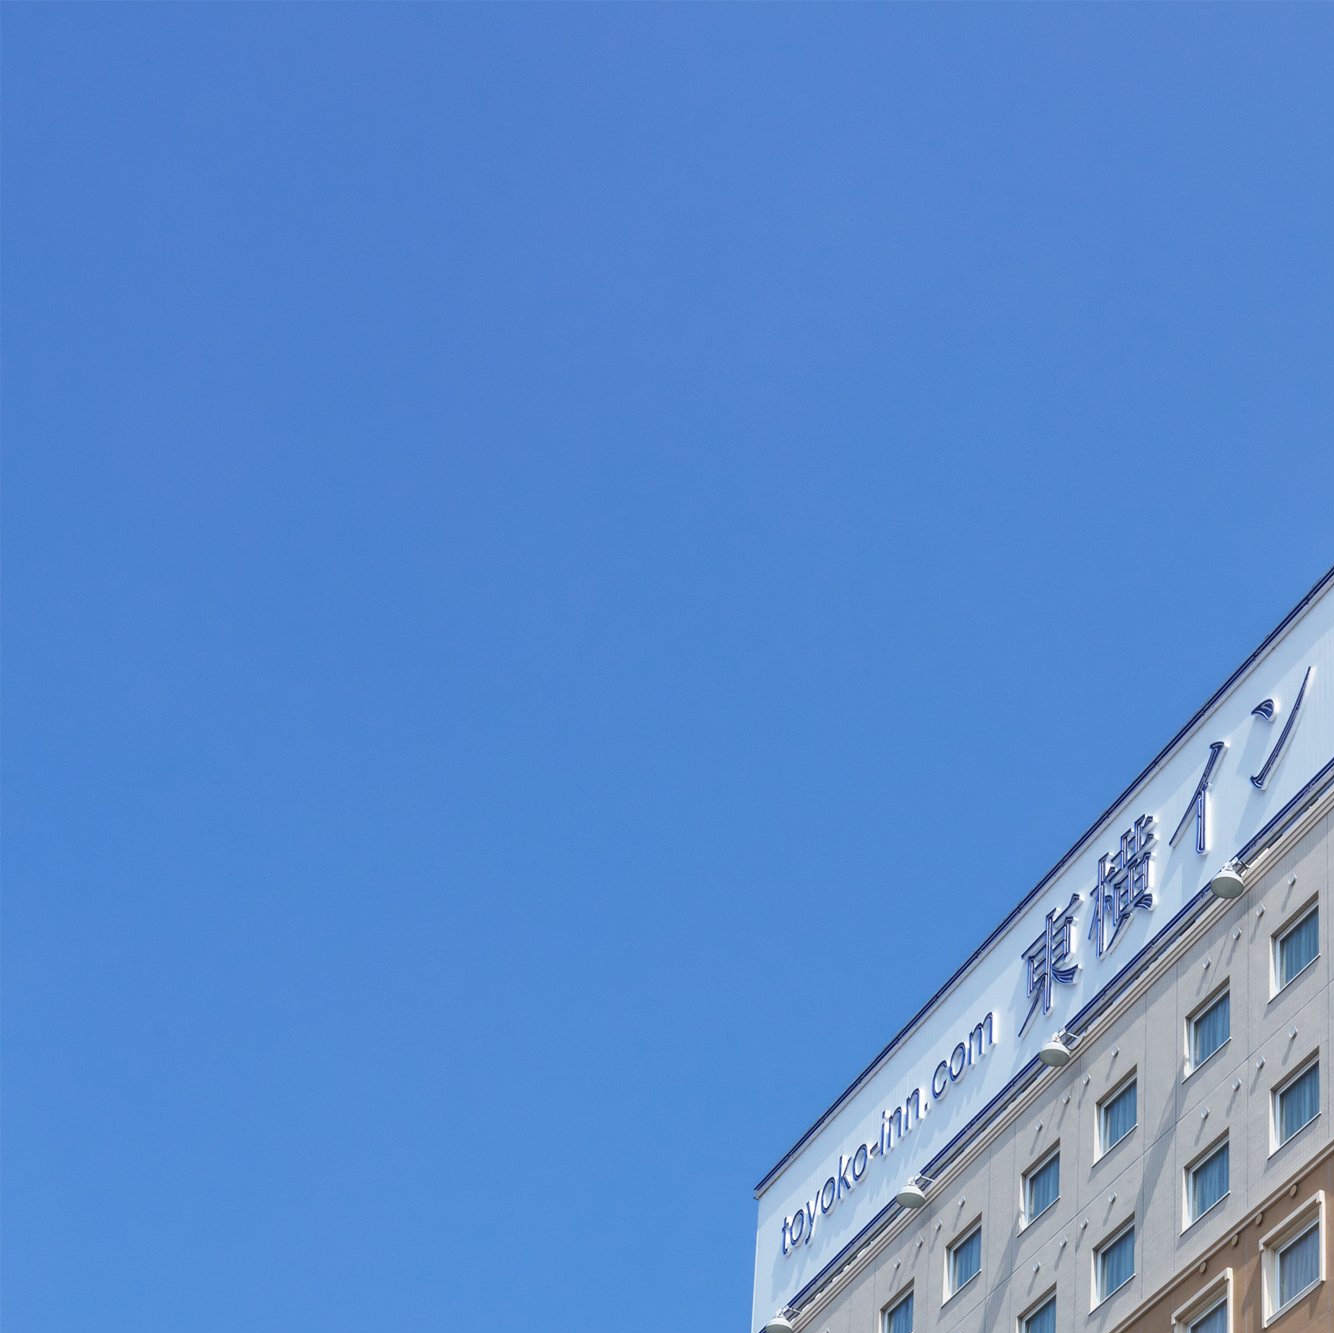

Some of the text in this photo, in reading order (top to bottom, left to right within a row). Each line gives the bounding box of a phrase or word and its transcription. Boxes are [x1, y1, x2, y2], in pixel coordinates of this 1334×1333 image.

[1018, 665, 1312, 1040] 東横イン
[780, 1010, 998, 1258] toyoko-inn.com
